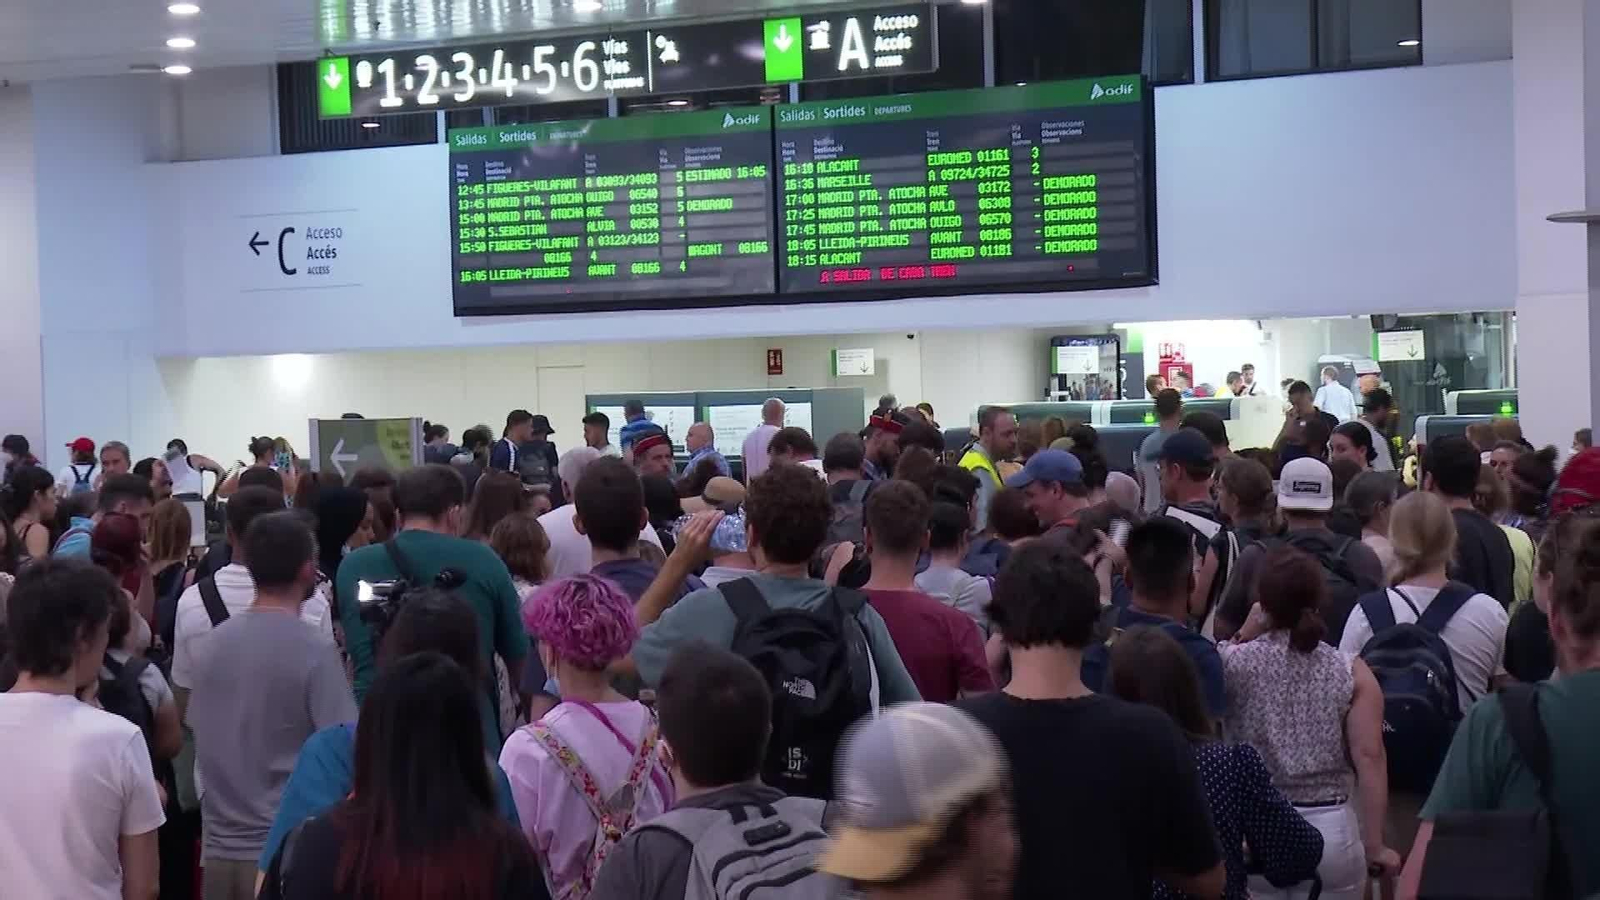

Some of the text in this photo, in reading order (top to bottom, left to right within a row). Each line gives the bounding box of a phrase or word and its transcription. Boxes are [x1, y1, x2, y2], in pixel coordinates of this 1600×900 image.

[873, 15, 919, 31] Acceso
[838, 17, 869, 71] A
[874, 32, 913, 51] Accés
[1105, 83, 1134, 96] adif
[735, 114, 760, 125] adif
[780, 105, 912, 122] Salidas Sortides DEPARTURES
[455, 134, 487, 146] Salidas
[500, 130, 536, 143] Sortides
[784, 146, 1039, 175] 16:10 ALACANT EUROMED 01161 3
[458, 184, 485, 196] 12:45
[487, 178, 577, 194] FIGUERES-VILAFANT
[585, 177, 592, 188] A
[676, 171, 683, 182] 5
[685, 168, 732, 182] ESTIMADO
[737, 165, 766, 178] 16:05
[785, 162, 1040, 191] 16:36 MARSEILLE A 09724/34725 2
[459, 199, 485, 210] 13:45
[487, 196, 520, 209] MADRID
[524, 195, 544, 206] PTA.
[550, 193, 584, 205] ATOCHA
[586, 191, 614, 202] OUIGO
[786, 193, 815, 206] 17:00
[818, 191, 854, 204] MADRID
[859, 189, 882, 201] PTA.
[889, 186, 926, 200] ATOCHA
[929, 185, 948, 197] AVE
[978, 181, 1011, 194] 03172
[1043, 175, 1096, 190] DEMORADO
[459, 198, 733, 224] 15:00 MADRID PTA. ATOCHA AVE 03152 5 DEMORADO
[786, 208, 815, 221] 17:25
[818, 206, 854, 219] MADRID
[859, 205, 883, 217] PTA.
[889, 202, 926, 215] ATOCHA
[929, 200, 955, 212] AVLO
[1044, 191, 1096, 205] DEMORADO
[460, 227, 486, 239] 15:30
[488, 224, 547, 237] S.SEBASTIAN
[587, 220, 615, 232] ALVIA
[679, 216, 685, 227] 4
[786, 224, 816, 236] 17:45
[819, 221, 855, 234] MADRID
[860, 220, 883, 232] PTA.
[890, 217, 927, 231] ATOCHA
[930, 215, 961, 228] OUIGO
[979, 212, 1011, 225] 06570
[1044, 207, 1096, 221] DEMORADO
[306, 227, 343, 240] Acceso
[460, 241, 486, 253] 15:50
[488, 236, 579, 252] FIGUERES-VILAFANT
[587, 236, 594, 247] A
[598, 232, 659, 246] 03123/34123
[787, 239, 816, 251] 18:05
[820, 234, 909, 250] LLEIDA-PIRINEUS
[930, 231, 962, 244] AVANT
[1045, 223, 1096, 237] DEMORADO
[278, 227, 297, 275] C
[306, 244, 337, 260] Accés
[590, 250, 597, 261] 4
[787, 254, 816, 267] 18:15
[820, 252, 861, 264] ALACANT
[931, 246, 975, 259] EUROMED
[980, 243, 1012, 257] 01181
[1045, 239, 1097, 253] DEMORADO
[307, 266, 330, 275] ACCESS
[461, 270, 487, 282] 16:05
[489, 266, 570, 280] LLEIDA-PIRINEUS
[588, 264, 616, 276] AVANT
[680, 260, 686, 272] 4
[833, 268, 871, 281] SALIDA
[788, 747, 802, 759] IS
